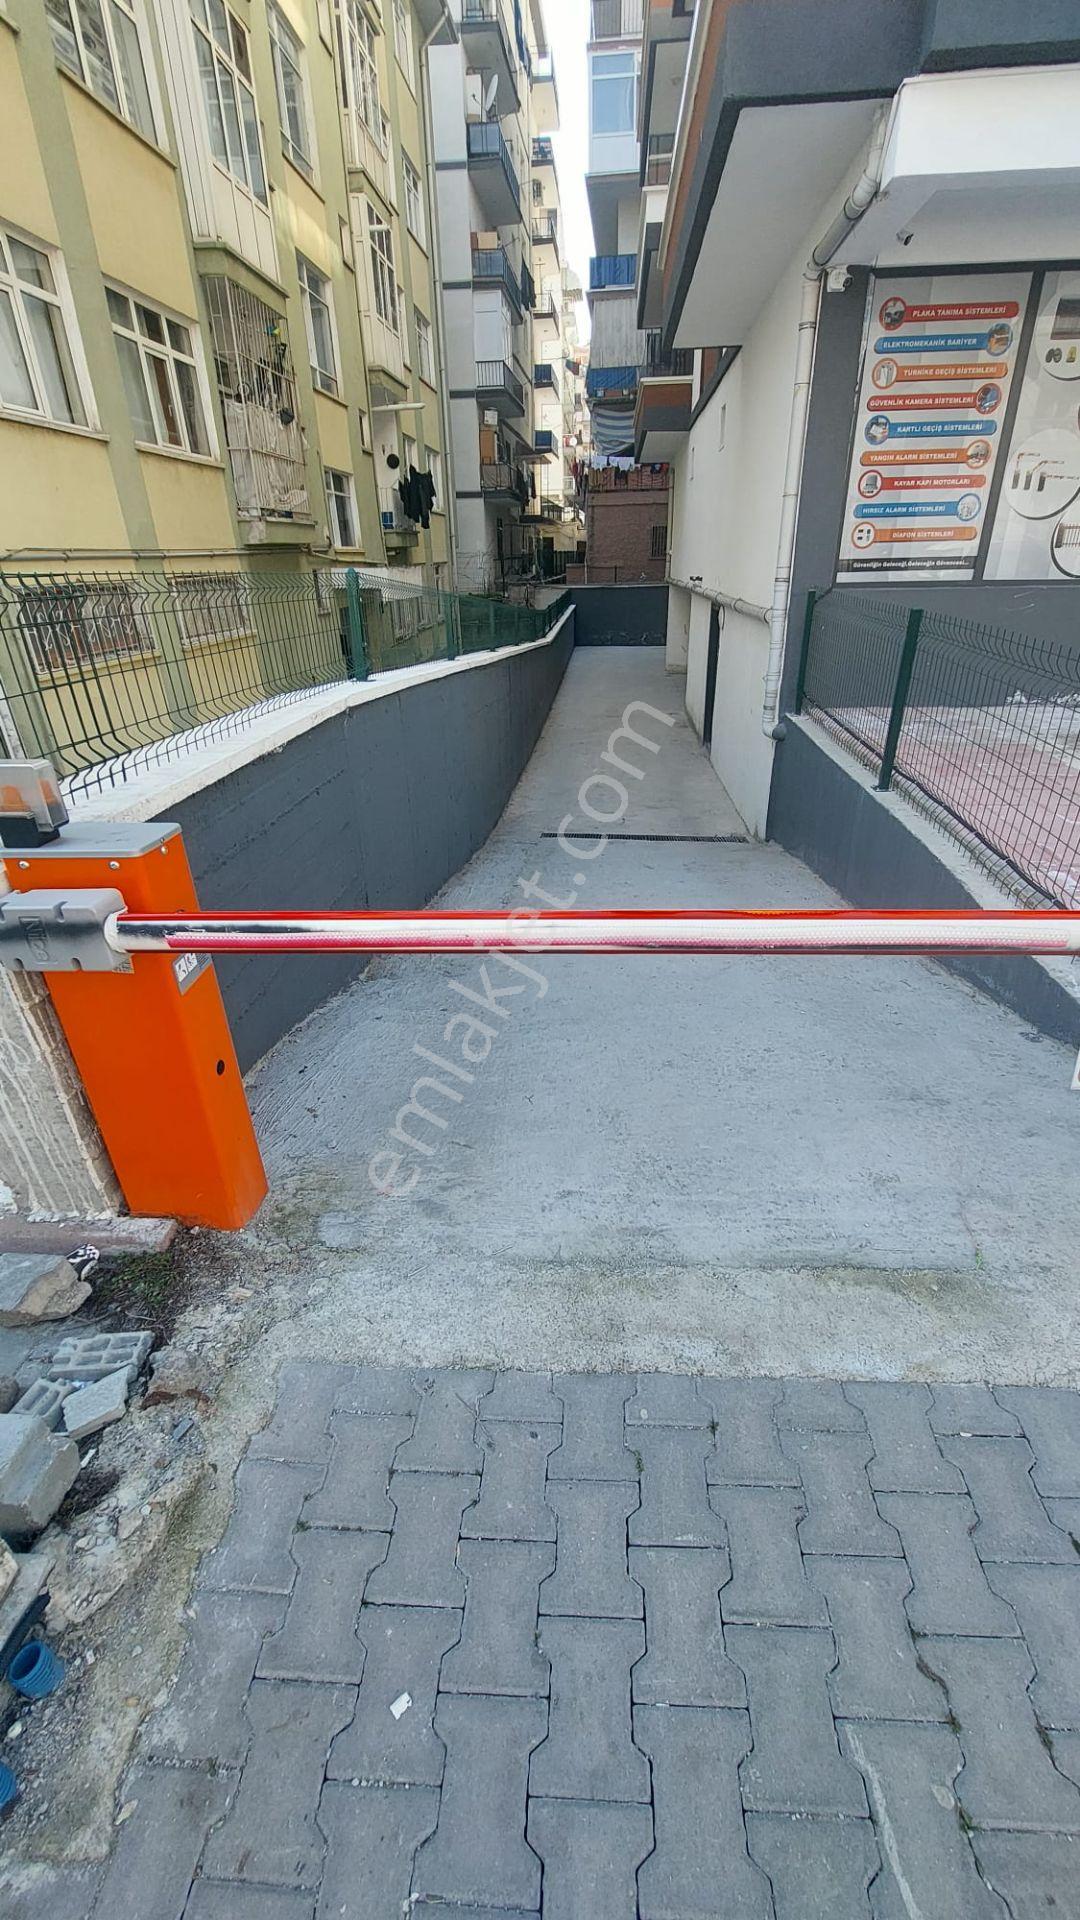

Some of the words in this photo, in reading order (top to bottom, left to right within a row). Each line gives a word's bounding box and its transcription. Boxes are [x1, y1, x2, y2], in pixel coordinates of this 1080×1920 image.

[911, 309, 935, 317] PLAKA
[937, 308, 963, 316] TANIMA
[947, 337, 977, 346] BARİYER
[904, 397, 933, 405] KAMERA
[897, 425, 921, 433] KARTLI
[870, 454, 894, 462] YANGIN
[894, 479, 915, 487] KAYAR
[933, 478, 970, 486] MOTORLARI
